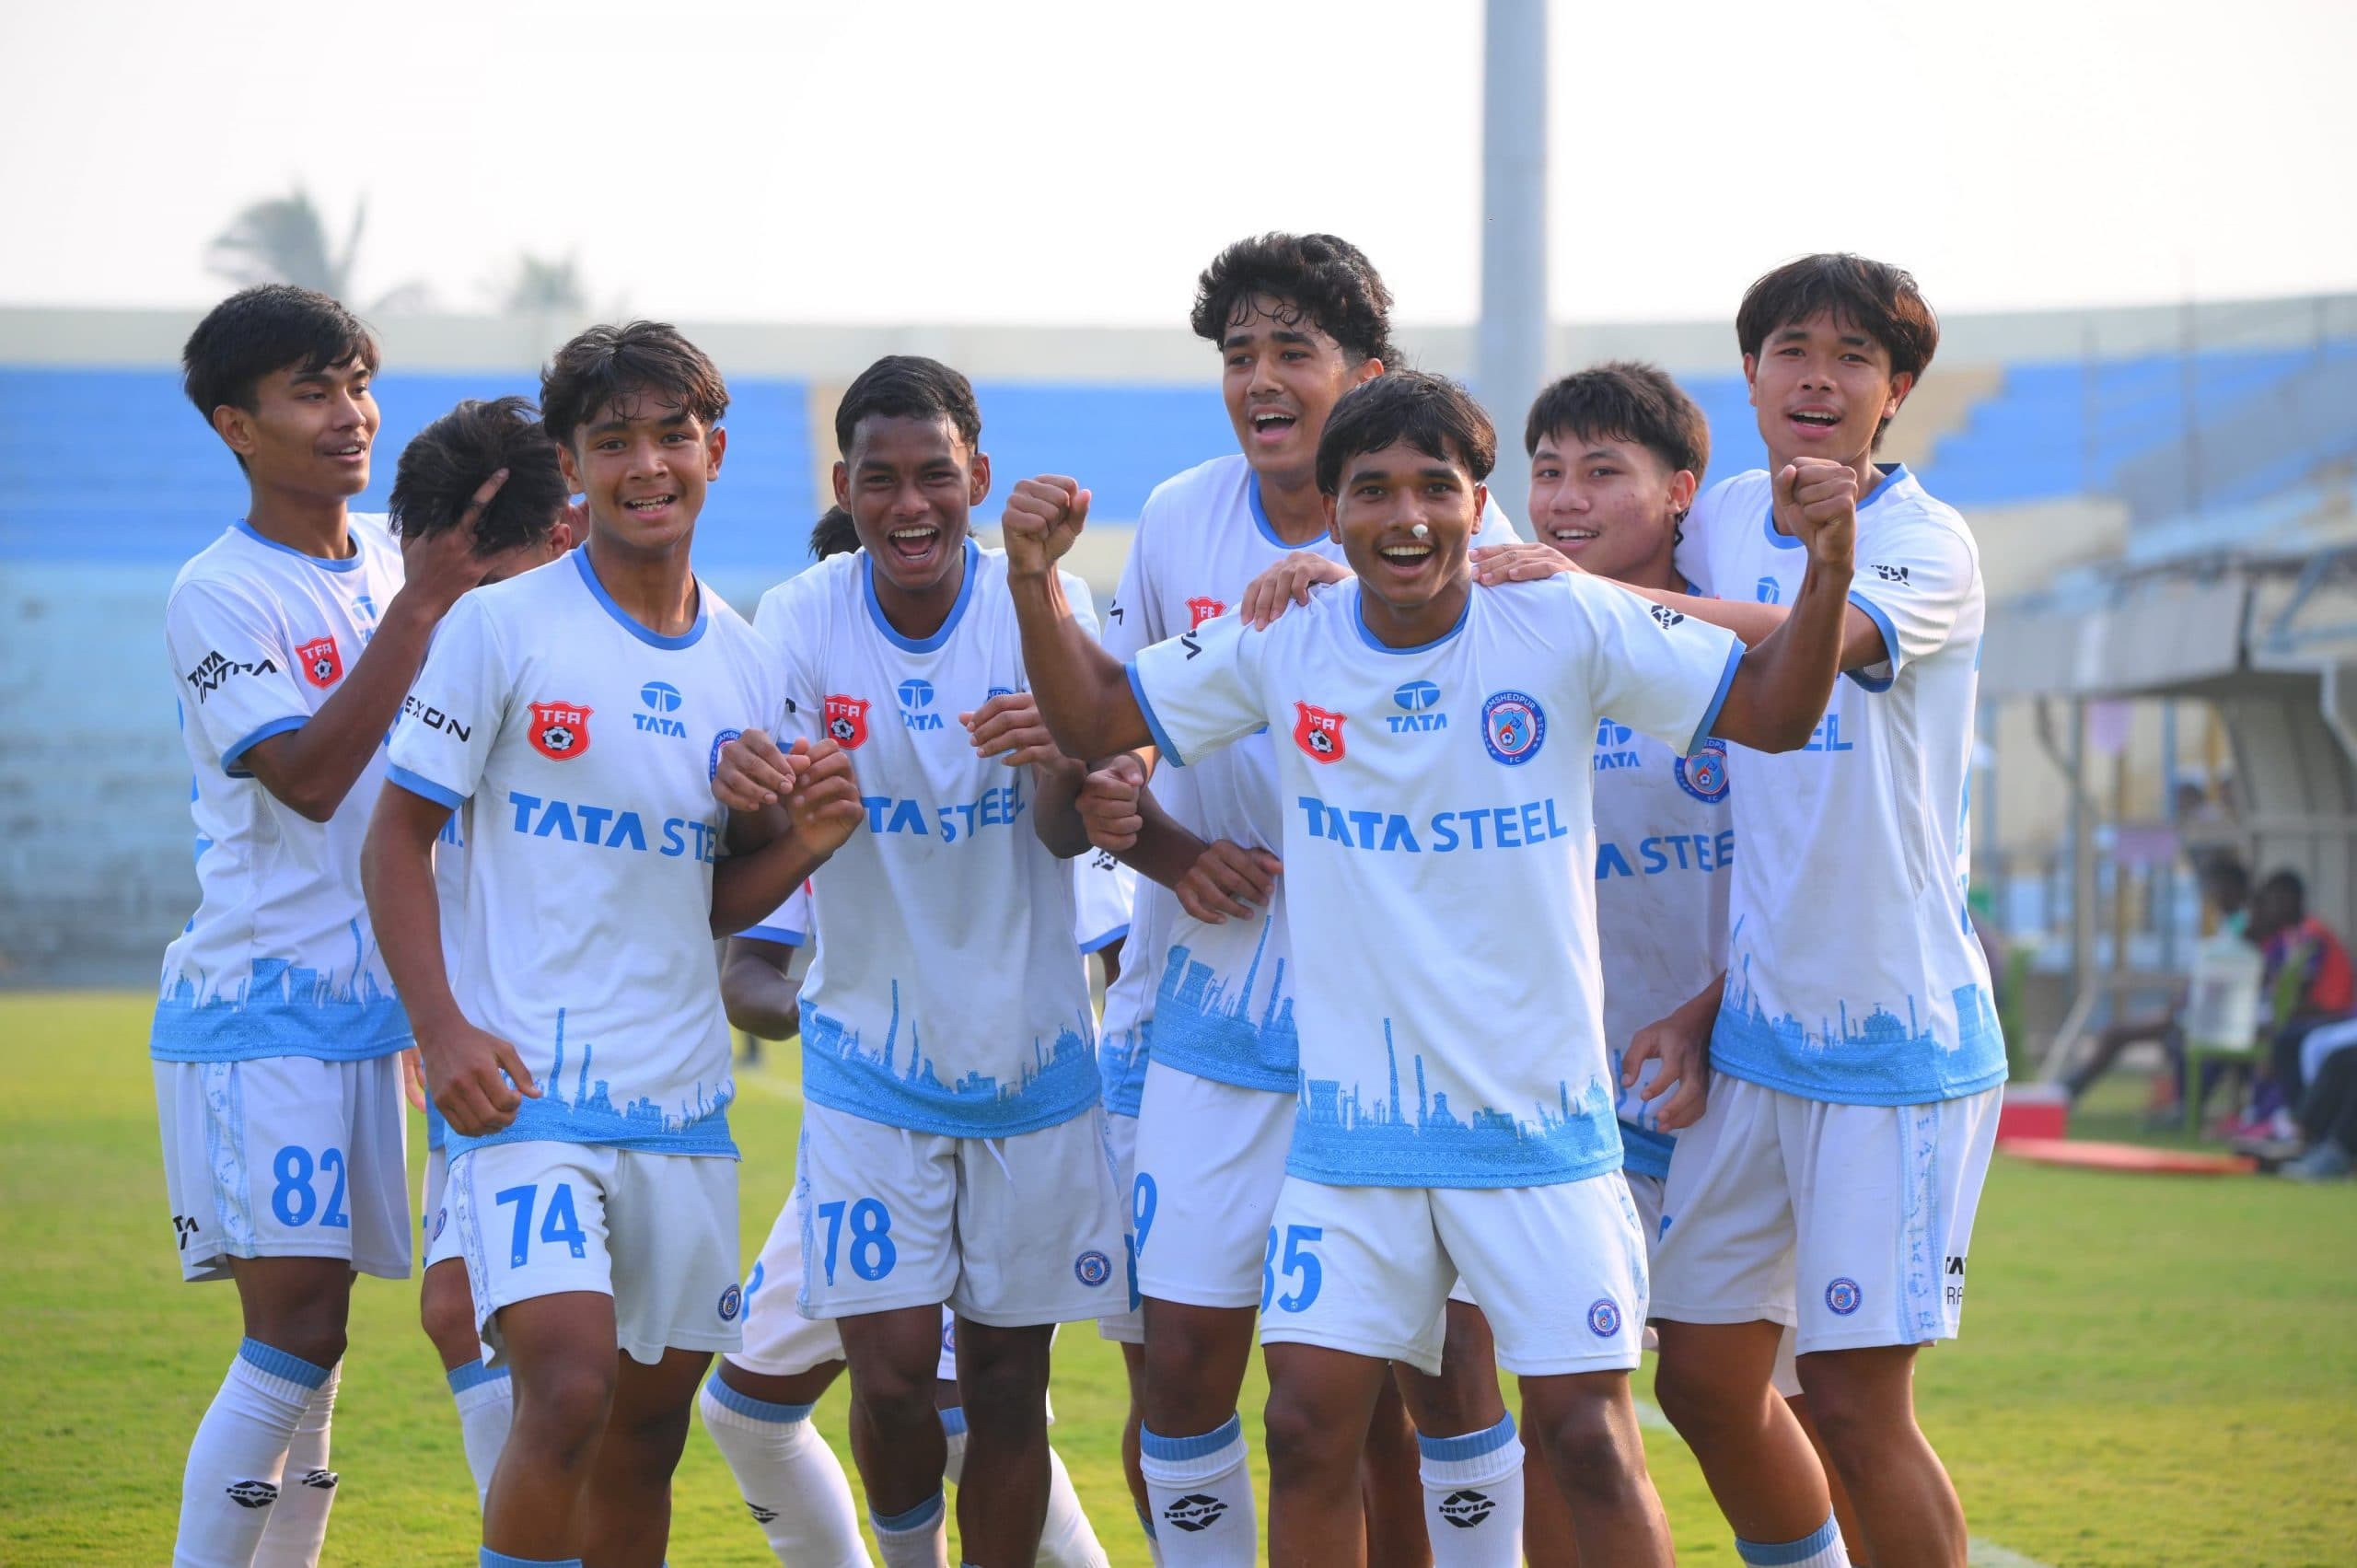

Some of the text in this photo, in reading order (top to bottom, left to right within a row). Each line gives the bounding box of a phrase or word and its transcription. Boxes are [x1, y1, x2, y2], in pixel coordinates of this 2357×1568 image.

[302, 641, 333, 661] TFA
[187, 650, 226, 688] TATA
[539, 708, 582, 726] TFA
[826, 702, 861, 717] TFA
[899, 708, 944, 731] TATA
[1306, 709, 1336, 731] TFA
[633, 713, 687, 739] TATA
[1386, 713, 1448, 734] TATA
[508, 790, 648, 853] TATA
[936, 780, 1026, 843] STEEL
[1298, 796, 1568, 853] TATA STEEL
[271, 1144, 349, 1229] 82
[495, 1182, 587, 1270] 74
[818, 1197, 898, 1287] 78
[1163, 1502, 1228, 1519] NIVIA
[1438, 1500, 1496, 1515] NIVIA
